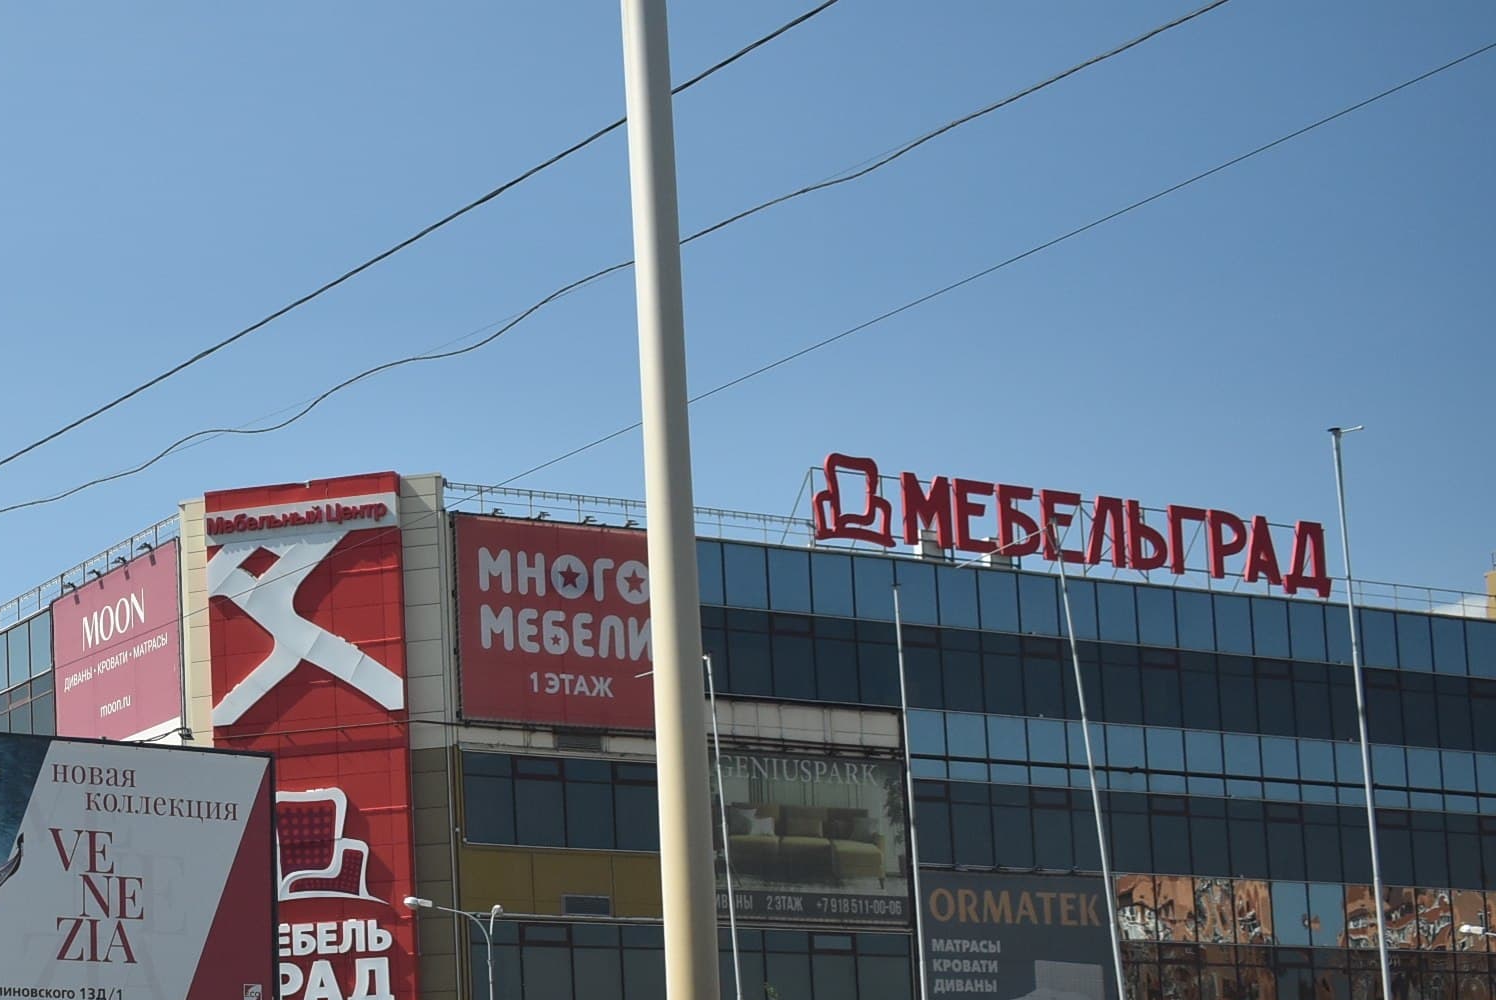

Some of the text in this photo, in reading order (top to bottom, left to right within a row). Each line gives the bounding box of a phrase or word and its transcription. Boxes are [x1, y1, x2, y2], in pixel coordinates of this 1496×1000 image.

[206, 502, 387, 536] Мебельный Центр
[899, 471, 1333, 598] МЕБЕЛЬГРАД
[478, 546, 651, 604] МНОГО
[82, 587, 145, 652] MOON
[480, 604, 653, 662] МЕБЕЛИ
[63, 632, 168, 693] ДИВАНЫ КРОВАТИ МАТРАСЫ
[529, 672, 614, 698] 1 ЭТАЖ
[100, 695, 131, 718] moon.ru
[51, 764, 137, 788] новая
[715, 754, 878, 786] GENIUSPARK
[85, 792, 239, 823] коллекция
[48, 828, 114, 874] VE
[79, 874, 144, 920] NE
[929, 887, 1103, 927] ORMATEK
[56, 917, 138, 964] ZIA
[278, 919, 393, 957] ЕБЕЛЬ
[931, 938, 1001, 953] МАТРАСЫ
[932, 959, 998, 974] КРОВАТИ
[934, 979, 997, 994] ДИВАНЫ
